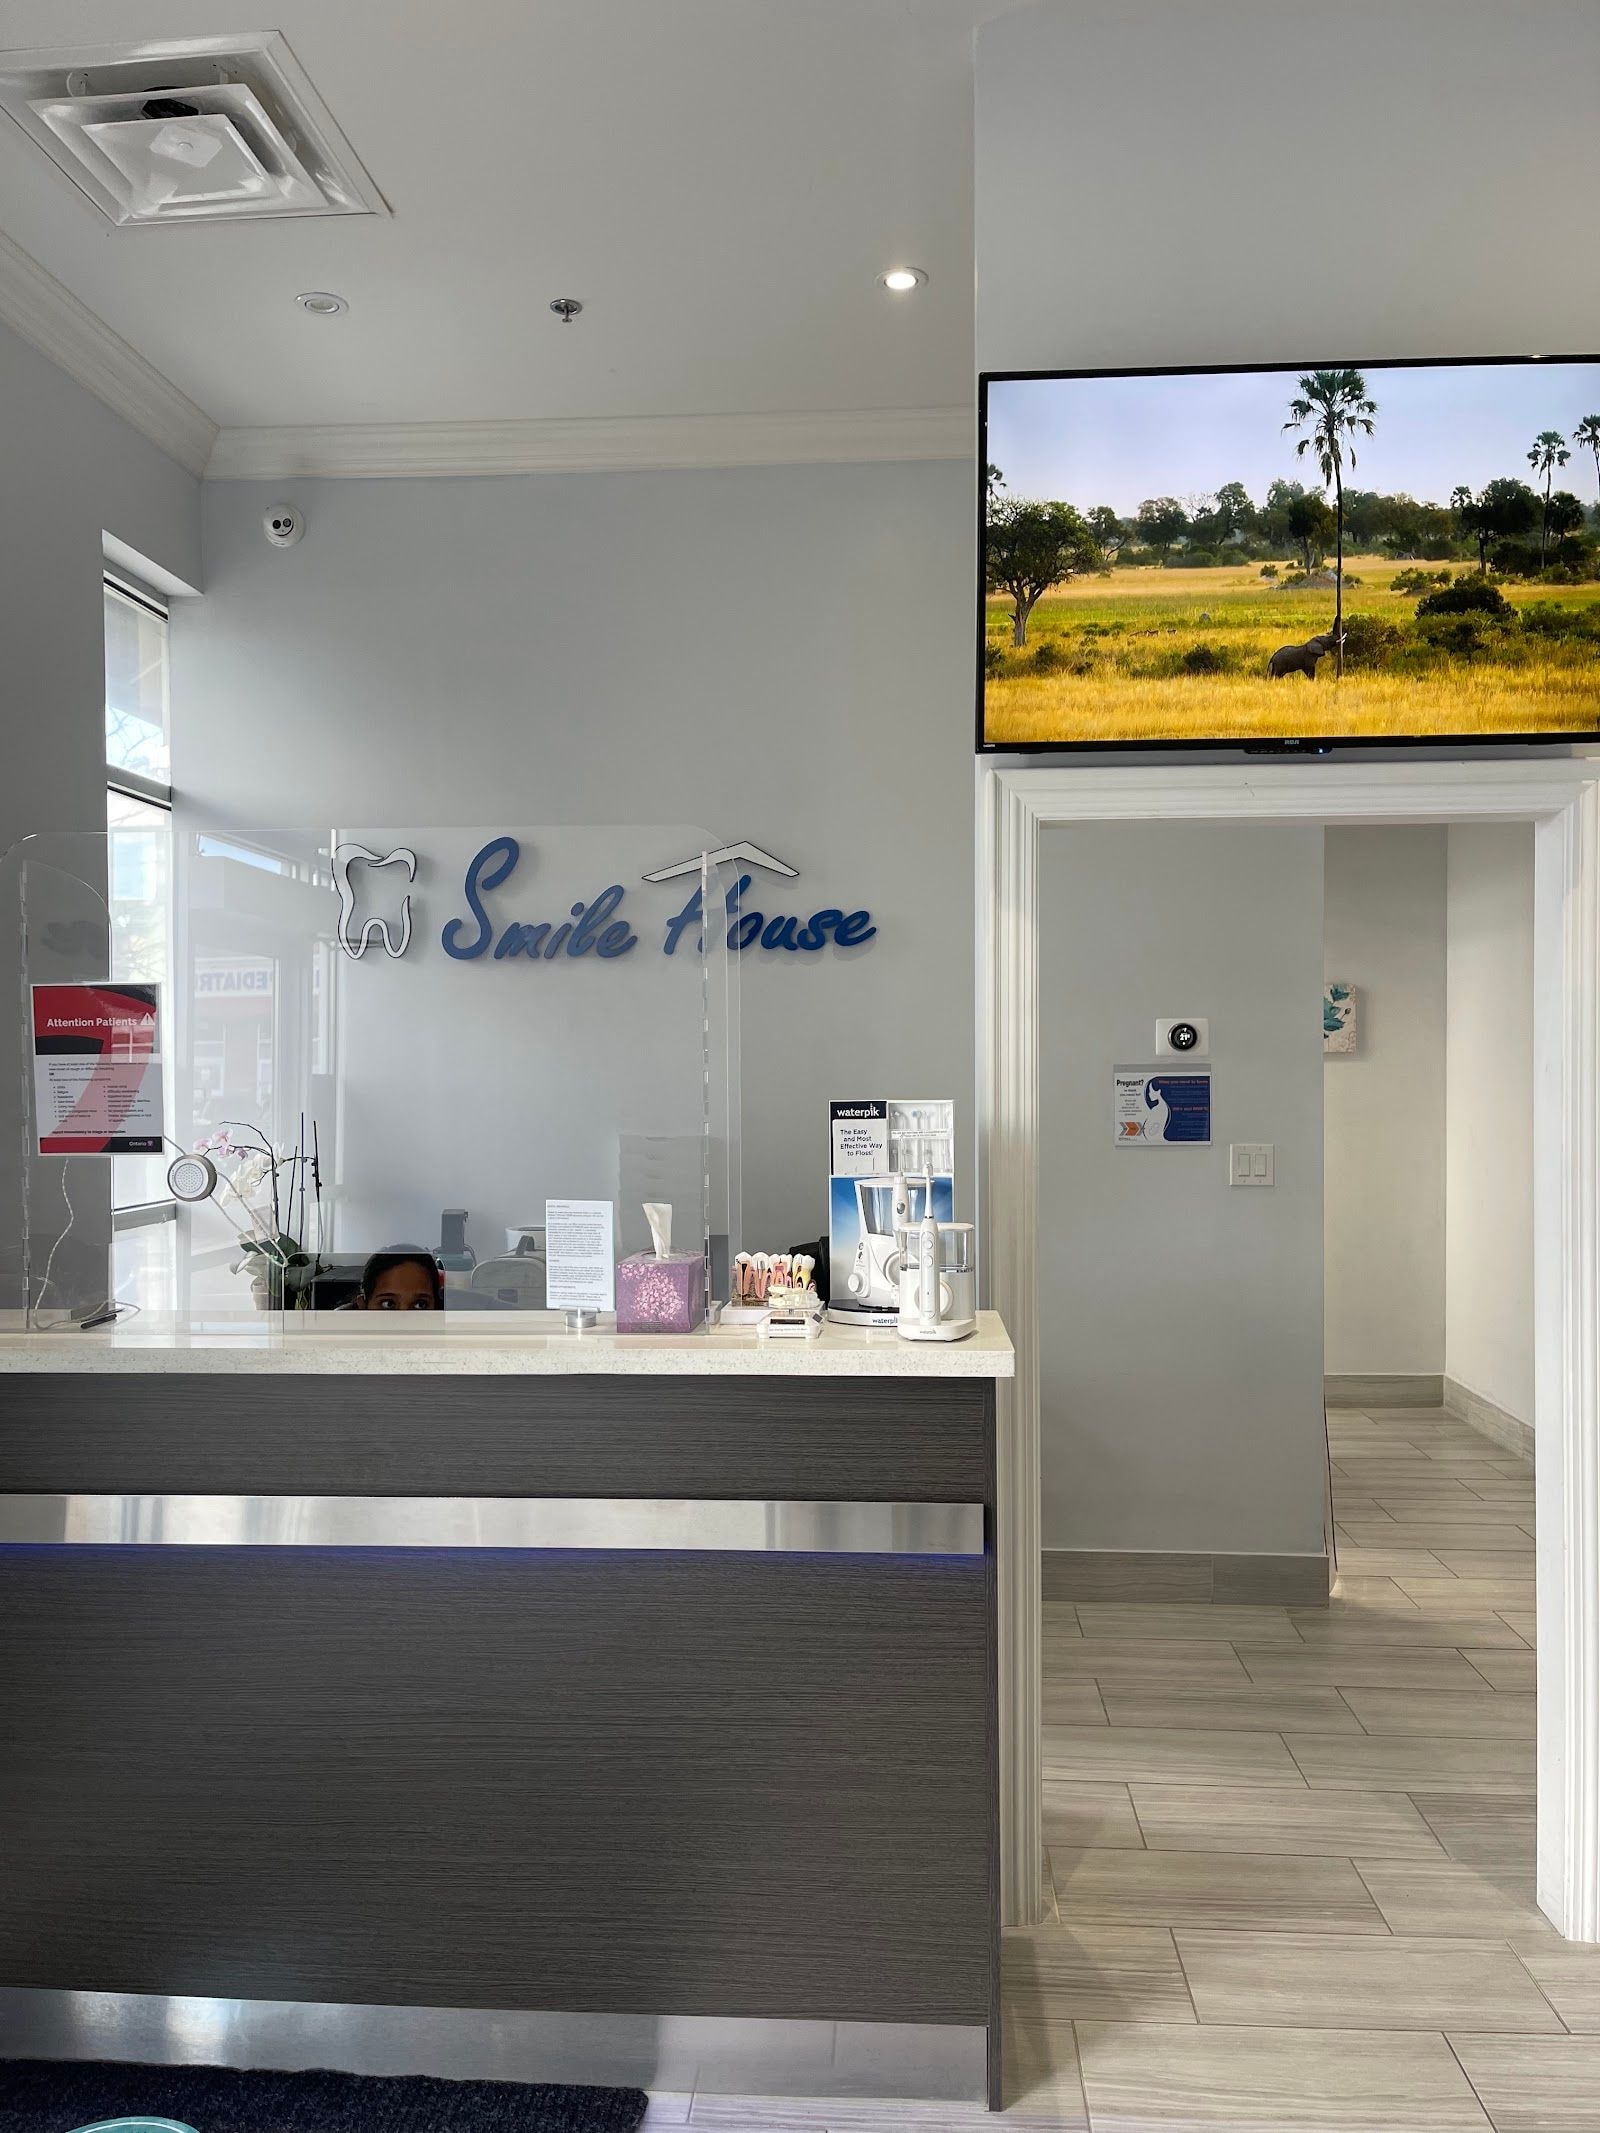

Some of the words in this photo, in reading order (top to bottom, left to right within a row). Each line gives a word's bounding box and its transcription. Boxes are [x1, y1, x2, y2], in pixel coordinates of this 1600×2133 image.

[441, 836, 638, 960] Smile
[664, 874, 877, 955] House
[47, 1017, 94, 1027] Attention
[96, 1017, 137, 1027] Patients
[1116, 1079, 1144, 1088] Pregnant?
[836, 1103, 880, 1118] waterpik
[872, 1315, 898, 1325] waterpi
